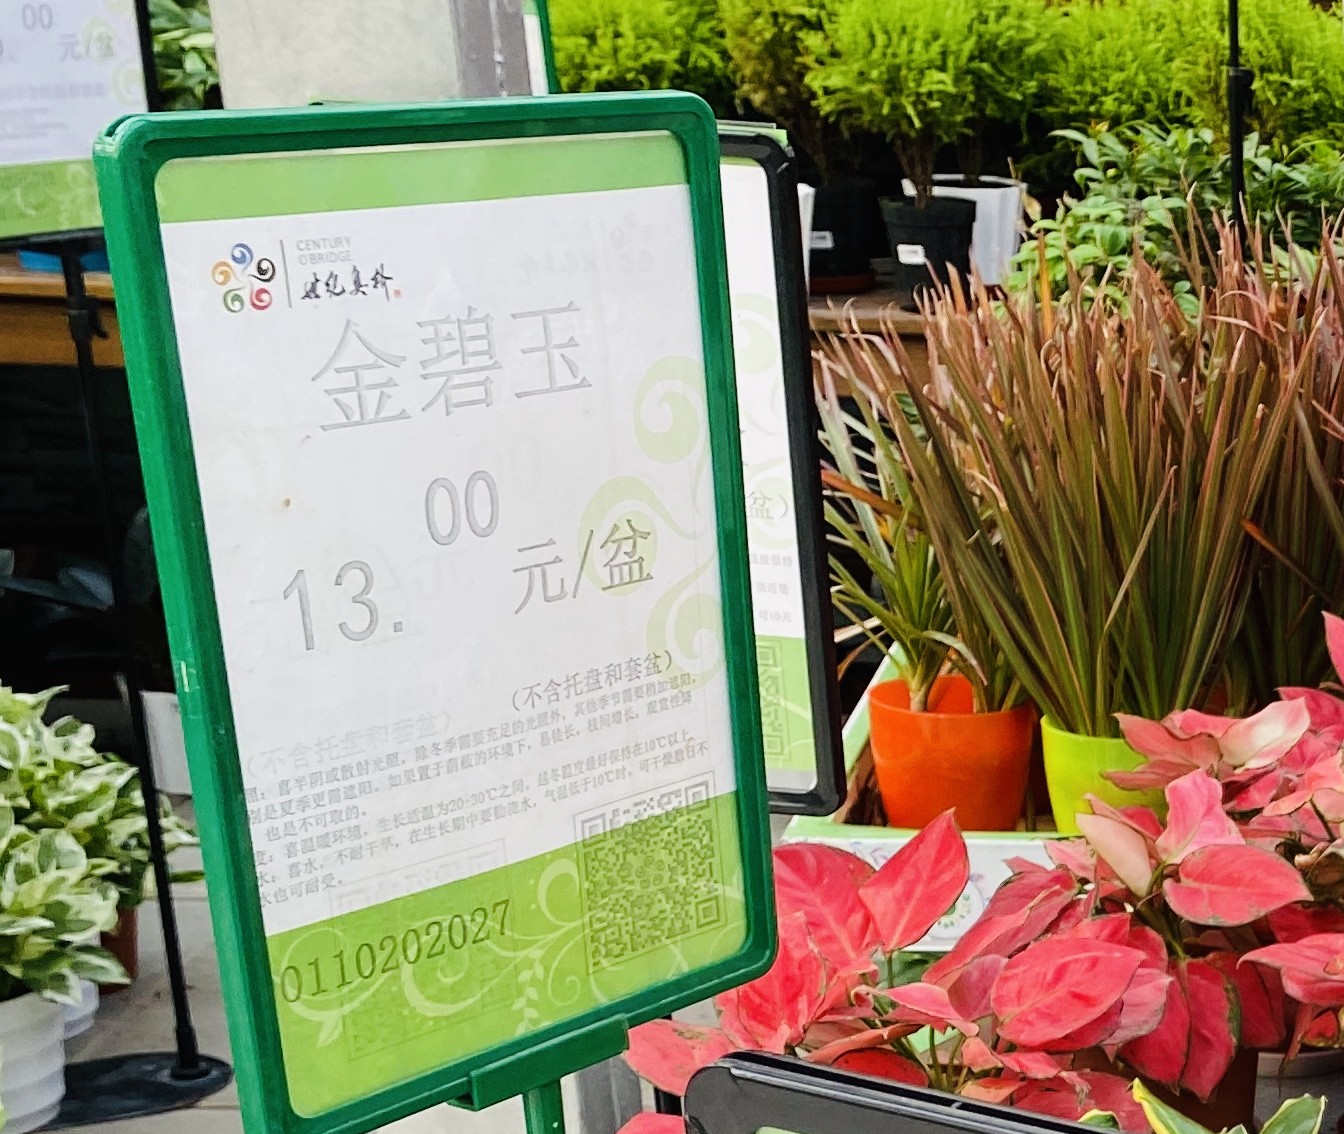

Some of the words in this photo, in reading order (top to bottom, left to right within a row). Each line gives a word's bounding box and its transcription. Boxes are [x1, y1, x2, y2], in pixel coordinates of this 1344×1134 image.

[297, 237, 351, 251] CENTURY
[311, 300, 592, 431] 金碧玉
[425, 470, 499, 546] 00
[513, 519, 654, 615] 元/盆
[281, 899, 511, 1003] 0110202027
